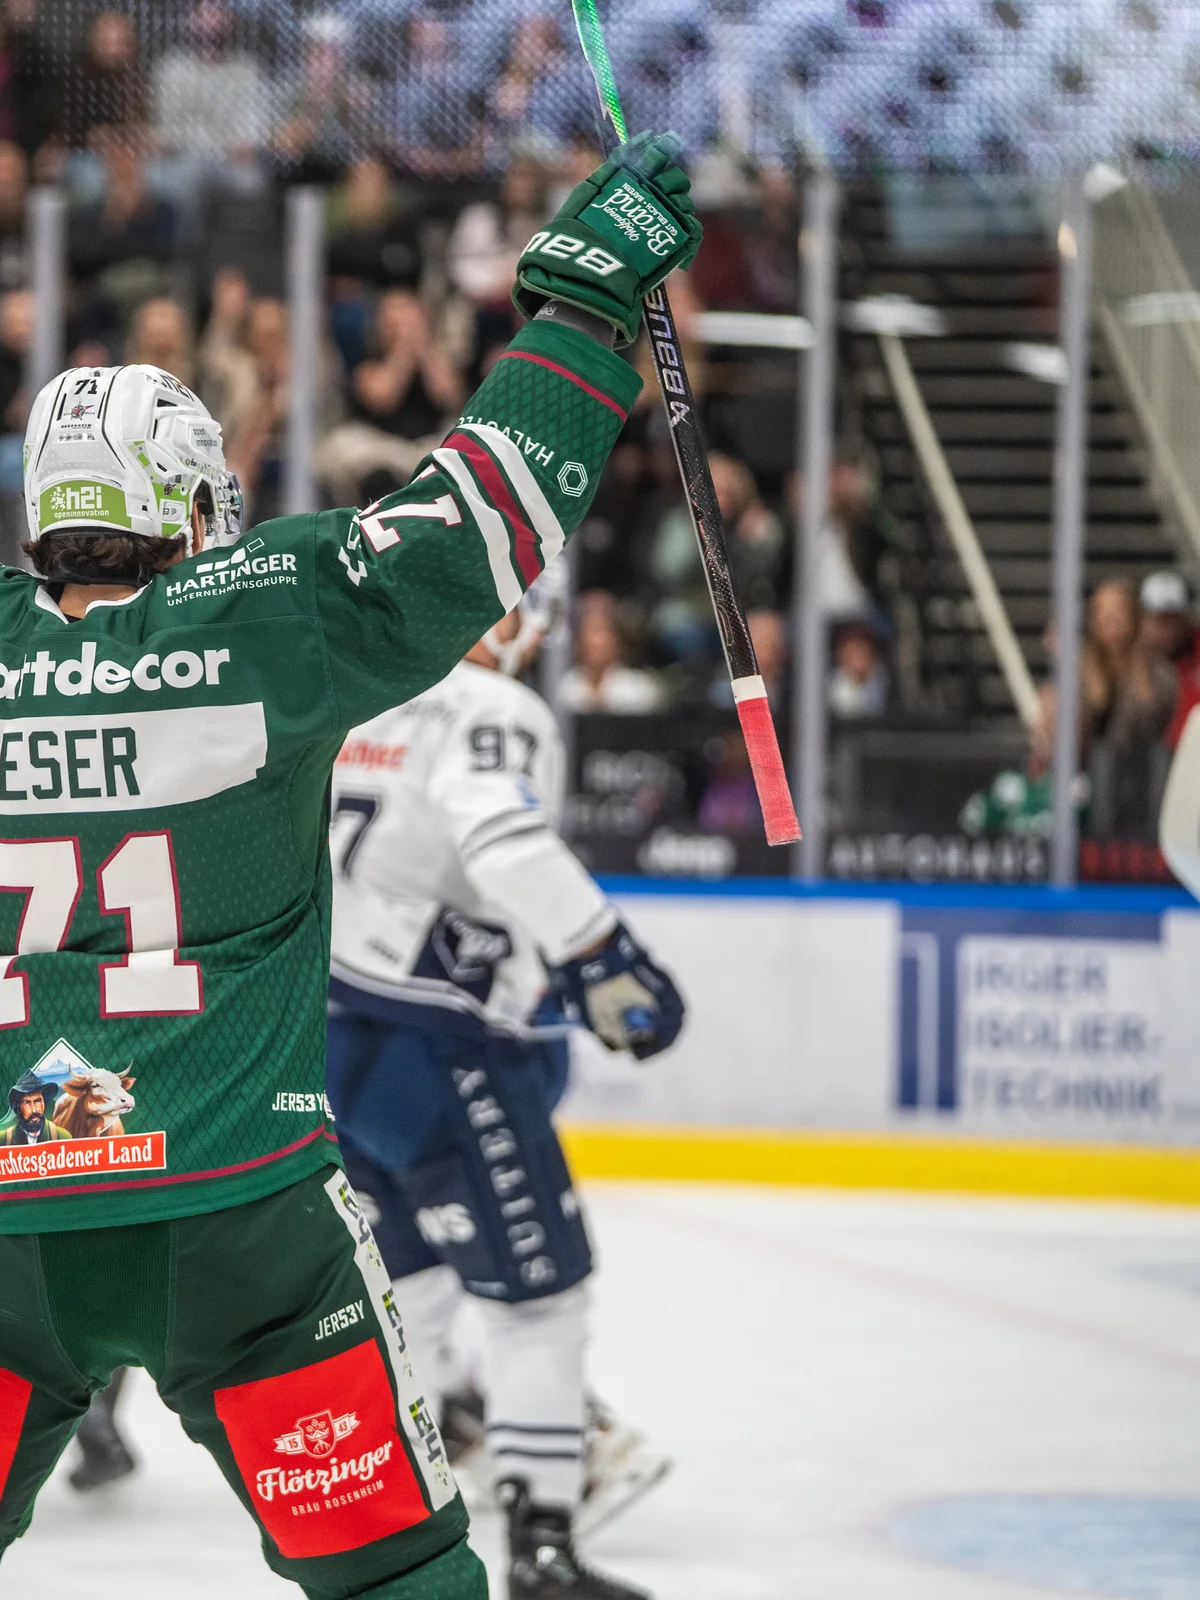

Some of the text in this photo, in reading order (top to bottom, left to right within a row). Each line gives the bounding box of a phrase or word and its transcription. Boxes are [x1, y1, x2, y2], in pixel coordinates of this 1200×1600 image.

[591, 188, 676, 256] Brand
[520, 231, 626, 276] BAU
[644, 287, 686, 396] BAUE
[74, 379, 98, 395] 71
[66, 486, 102, 510] h2i
[54, 509, 110, 519] openinnovation
[166, 553, 298, 597] HARTINGER
[167, 576, 298, 606] UNTERNEHMENSGRUPPE
[469, 723, 538, 776] 97
[331, 787, 382, 884] 7
[108, 1137, 153, 1164] Land
[337, 1420, 348, 1433] 43
[288, 1437, 298, 1449] 15
[256, 1440, 394, 1501] Flötzinger
[324, 1479, 385, 1510] ROSENHEIM
